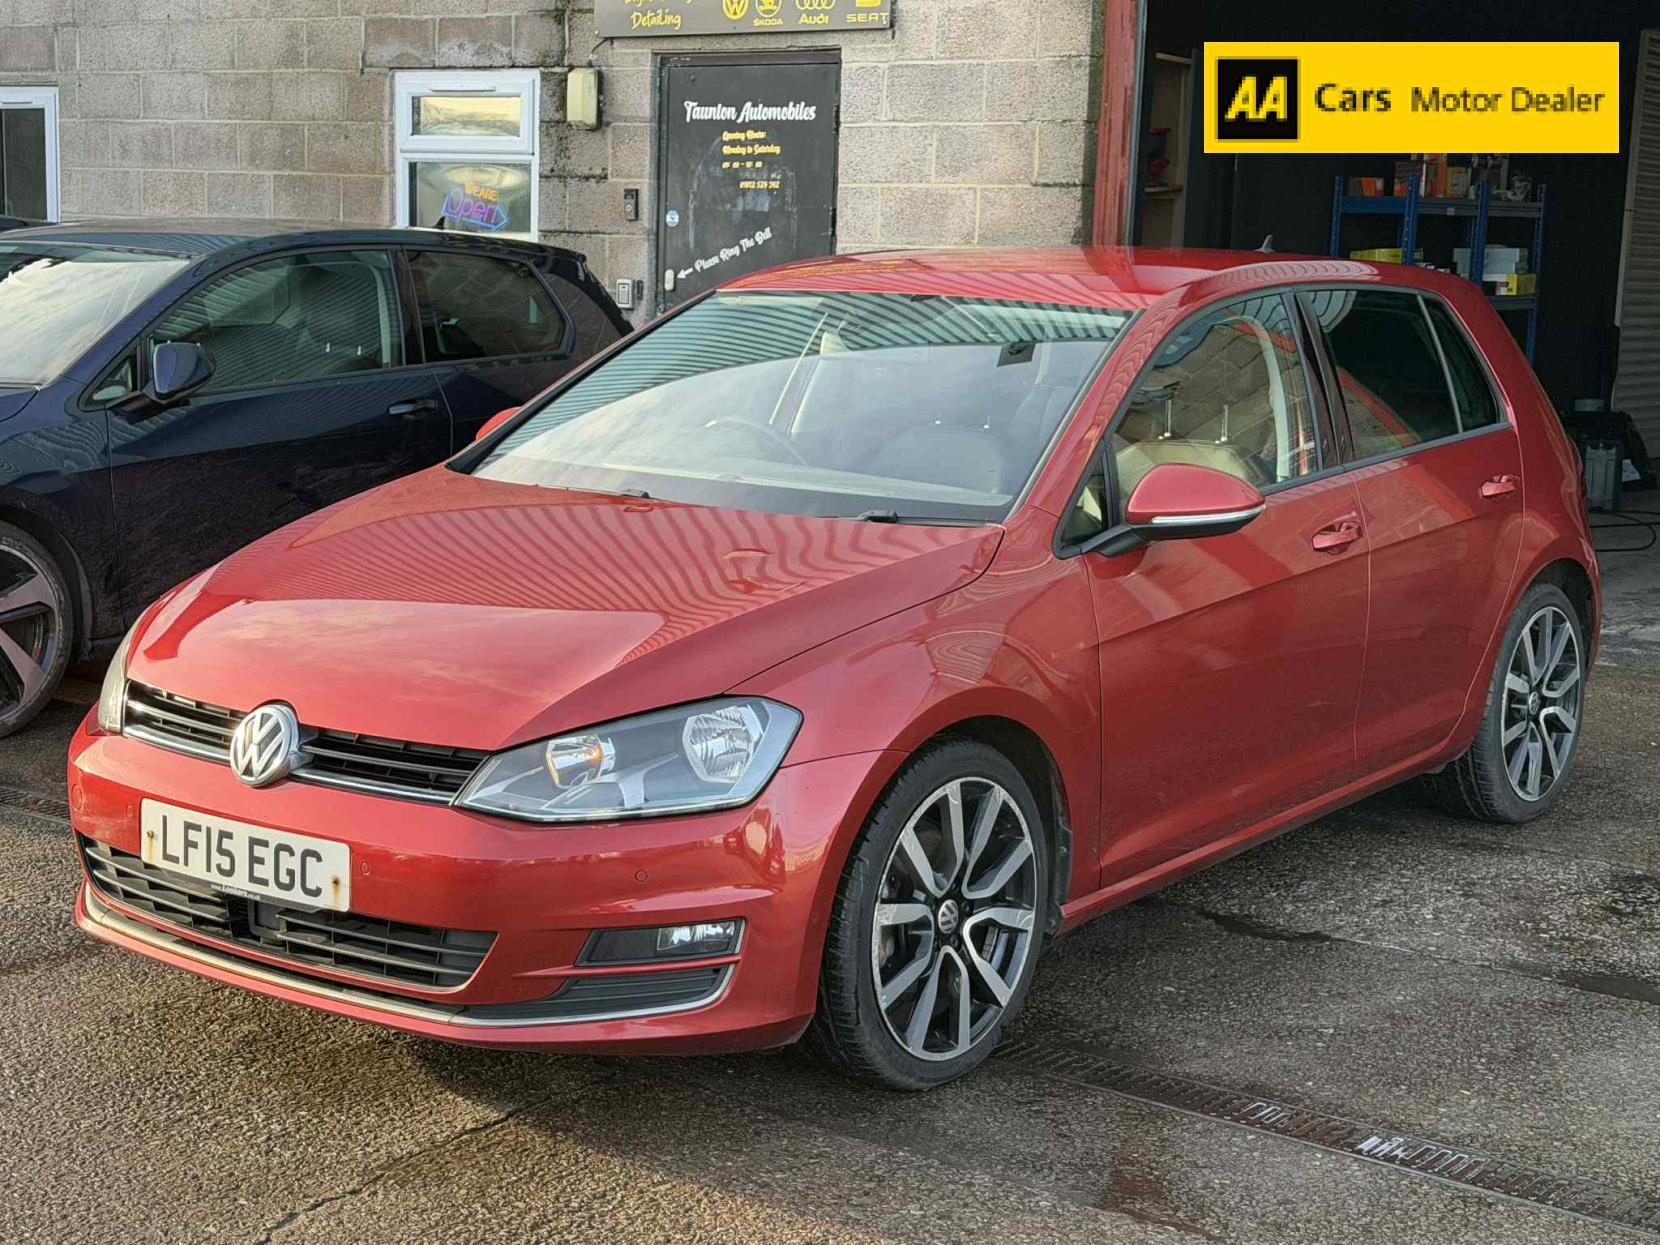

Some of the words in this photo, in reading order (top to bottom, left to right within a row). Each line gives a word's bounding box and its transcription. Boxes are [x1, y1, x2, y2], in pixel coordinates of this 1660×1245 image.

[630, 8, 681, 30] Detailing
[798, 13, 829, 24] Audi
[846, 12, 889, 23] SEAT
[683, 100, 738, 123] Taunton
[736, 101, 817, 124] Automobiles
[447, 188, 497, 223] Open
[694, 255, 720, 273] Please
[719, 245, 740, 262] Ring
[739, 237, 755, 252] The
[754, 226, 772, 246] Bell
[161, 815, 236, 878] LF15
[247, 835, 324, 898] EGC
